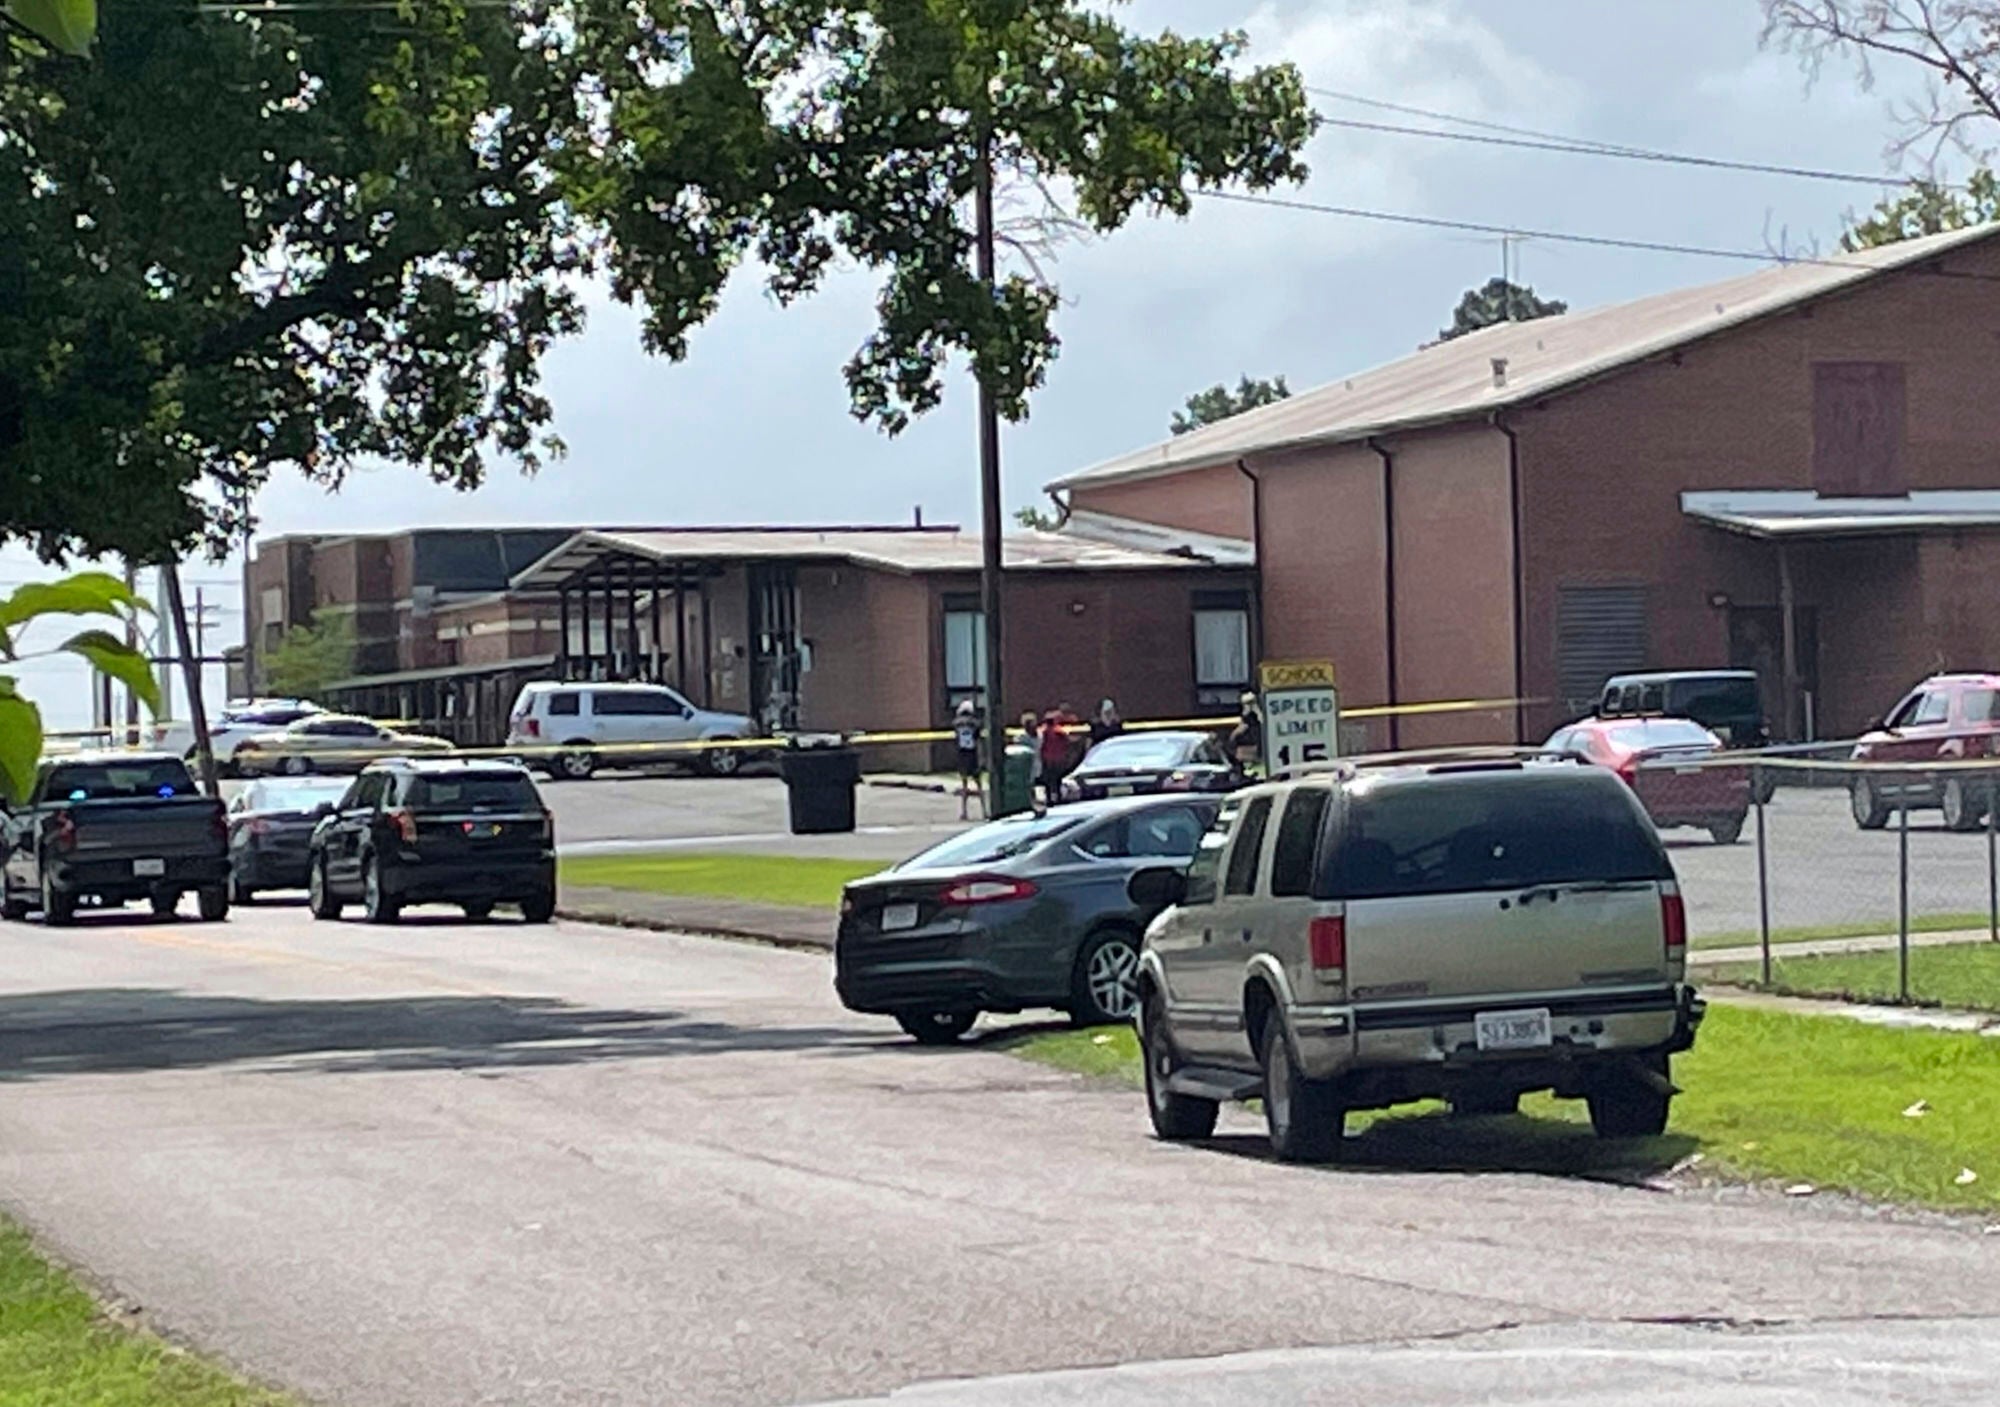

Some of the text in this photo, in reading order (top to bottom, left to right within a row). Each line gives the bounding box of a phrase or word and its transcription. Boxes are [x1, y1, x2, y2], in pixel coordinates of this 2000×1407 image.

[1267, 667, 1329, 683] SCHOOL
[1268, 697, 1333, 716] SPEED
[1276, 720, 1326, 737] LIMIT
